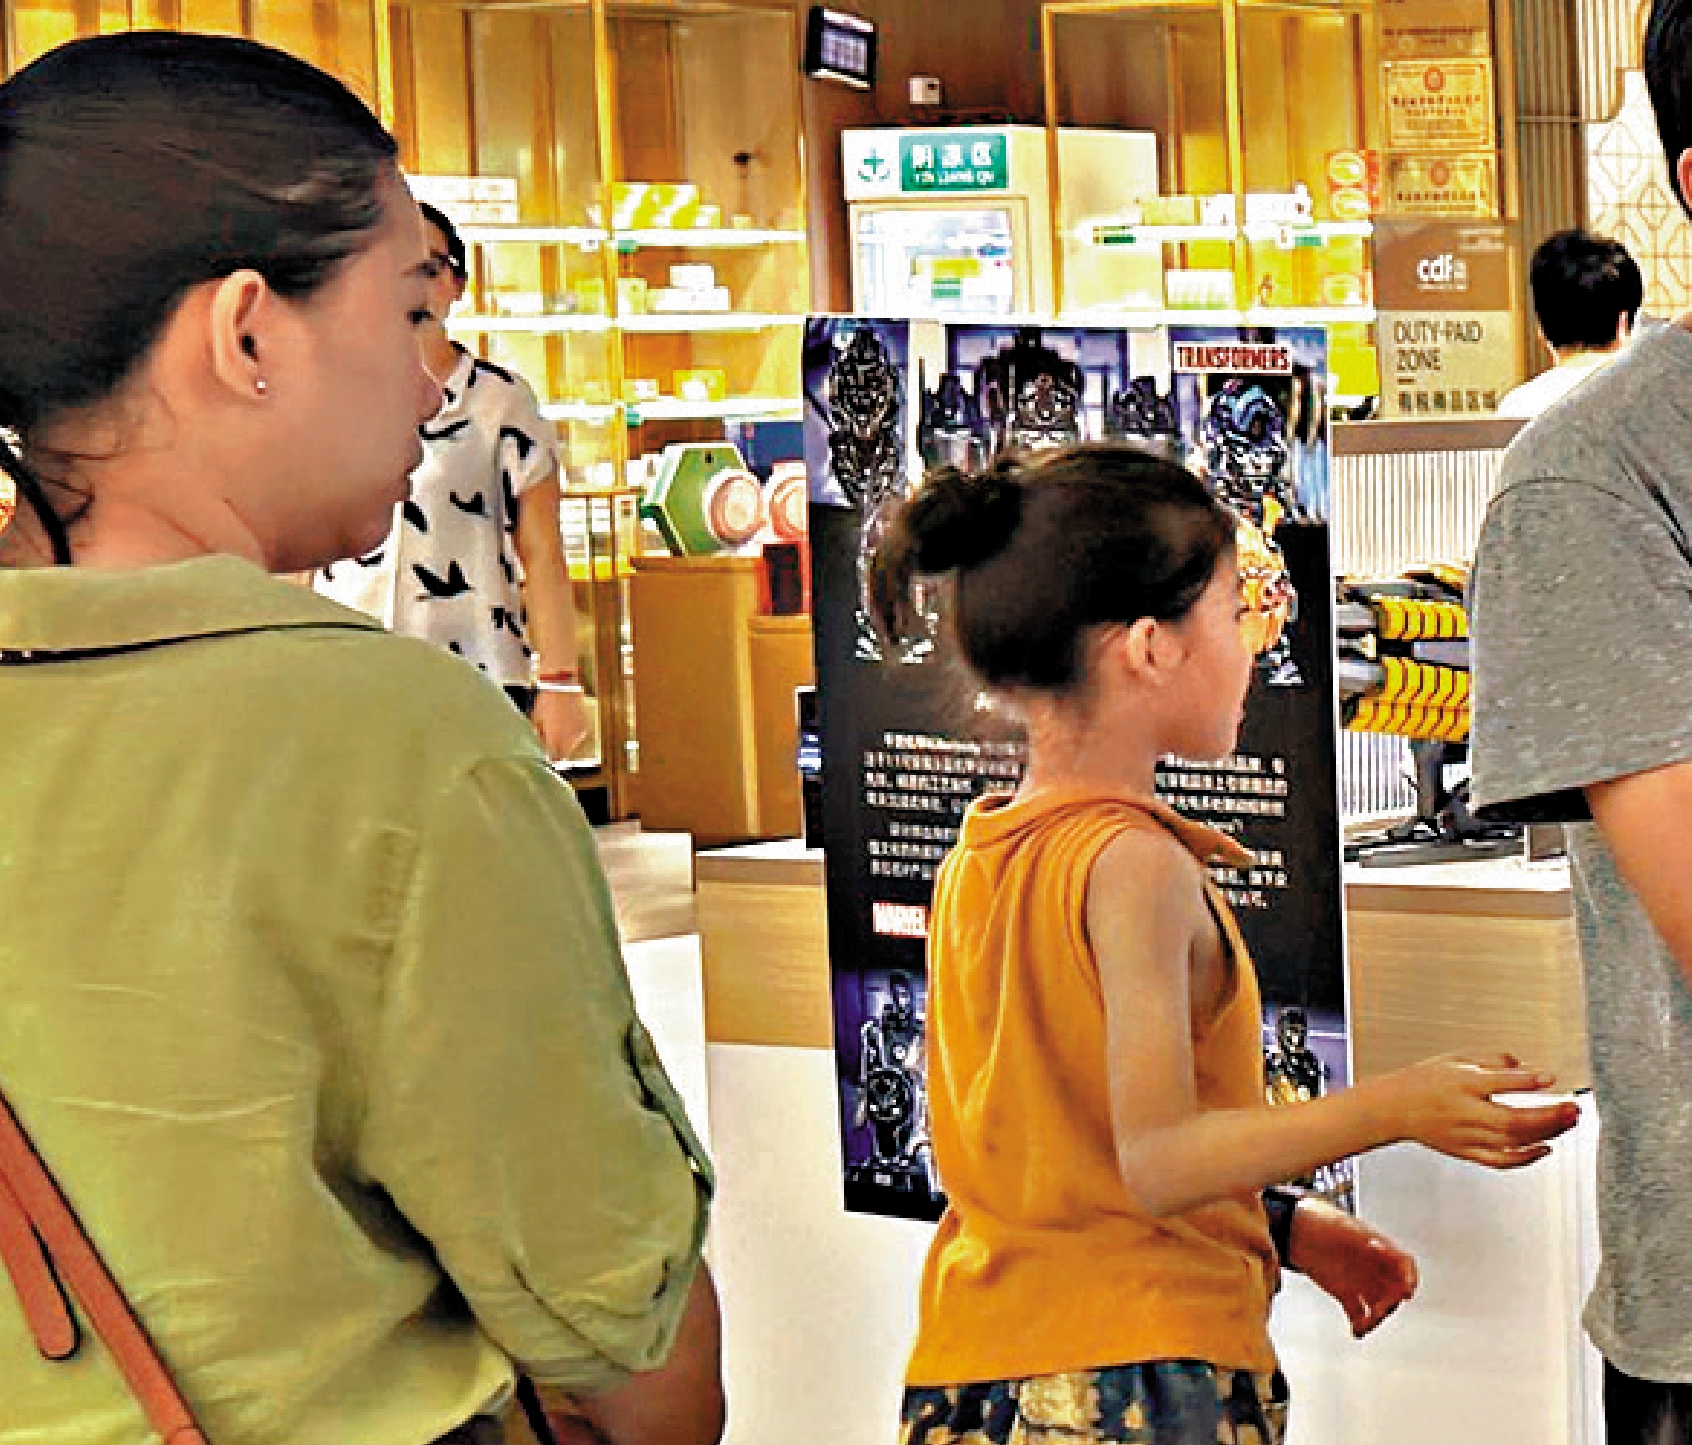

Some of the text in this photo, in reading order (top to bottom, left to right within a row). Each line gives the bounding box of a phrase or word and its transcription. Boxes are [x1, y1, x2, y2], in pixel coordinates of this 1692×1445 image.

[1417, 253, 1454, 282] cdf
[1393, 320, 1485, 345] DUTY-PAID
[1176, 346, 1288, 371] TRANSFORMERS
[1396, 347, 1442, 372] ZONE
